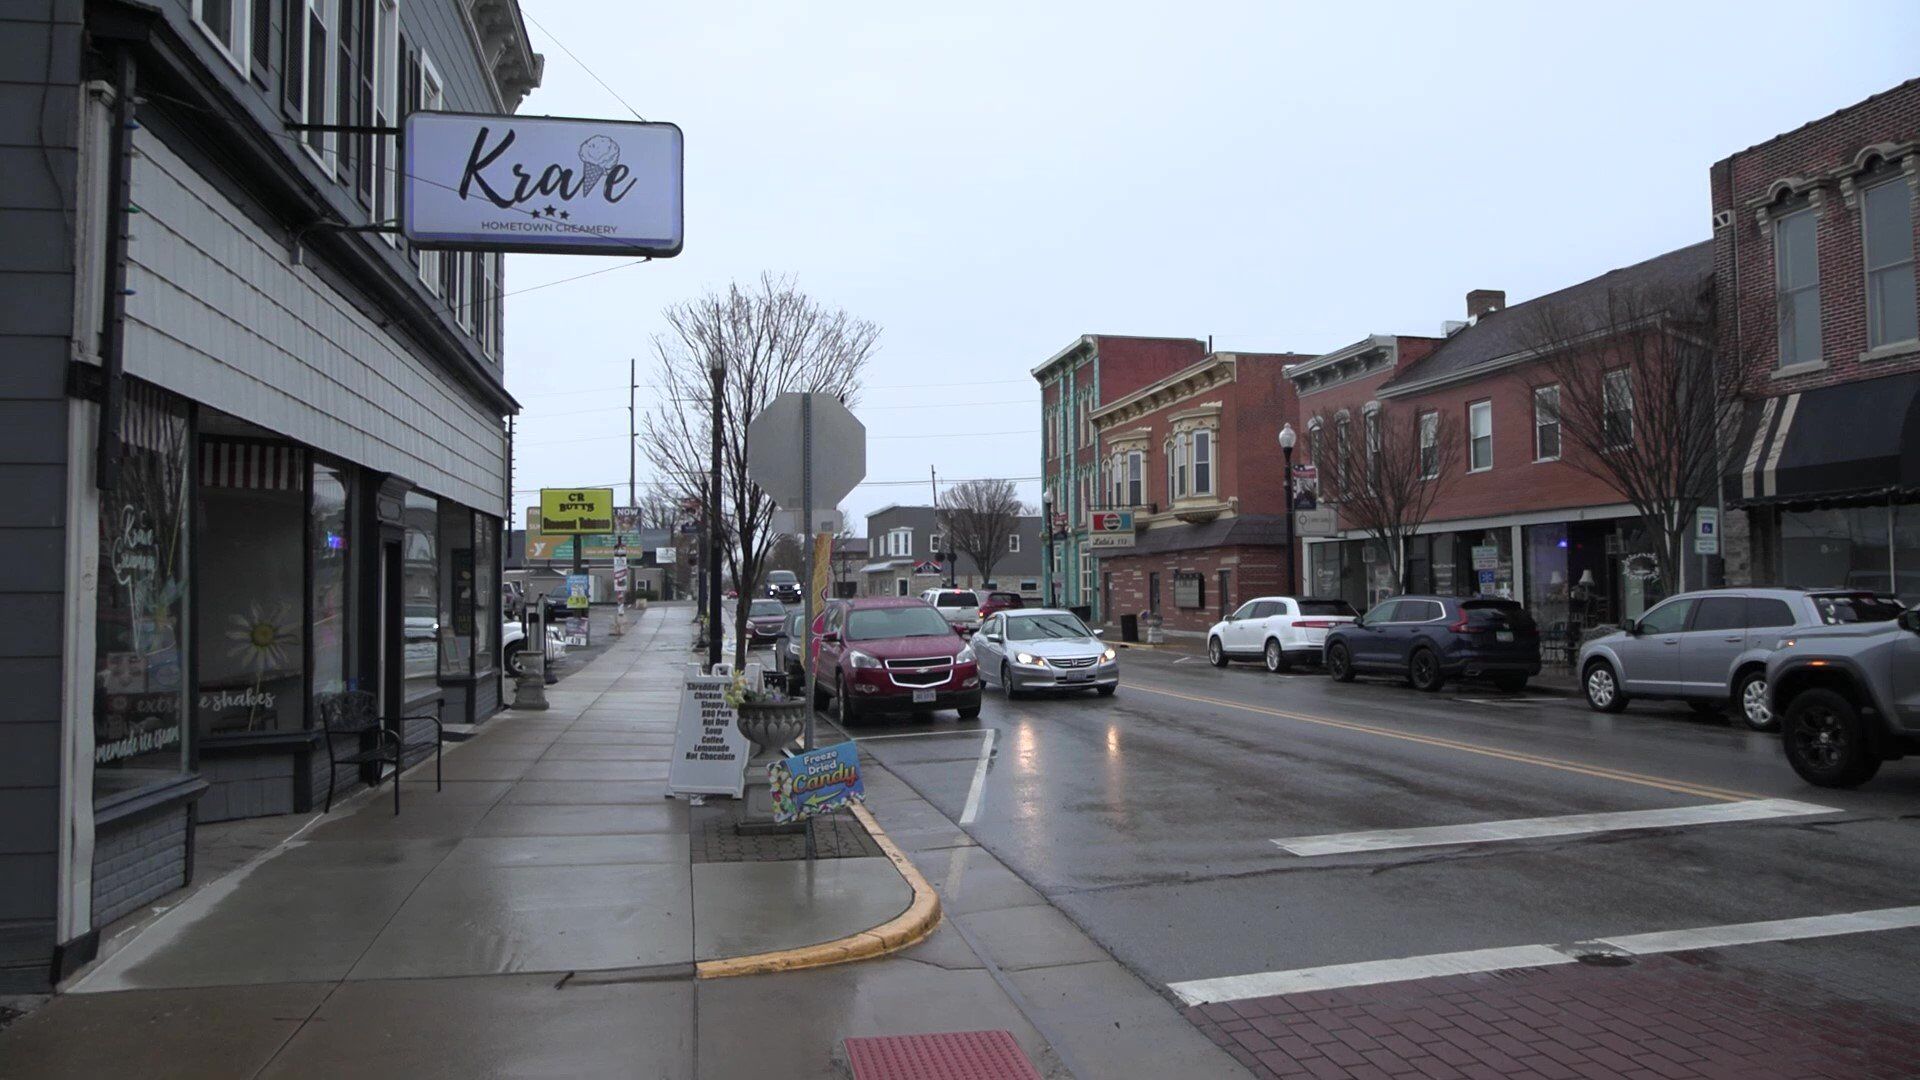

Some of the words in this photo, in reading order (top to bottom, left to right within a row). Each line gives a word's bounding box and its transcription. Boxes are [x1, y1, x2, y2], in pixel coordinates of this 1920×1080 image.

[458, 126, 638, 209] Krave
[481, 221, 553, 233] HOMETOWN
[555, 222, 618, 235] CREAMERY
[559, 503, 595, 512] BUTTS
[617, 508, 639, 516] NOW
[686, 682, 721, 691] Shredded
[212, 688, 276, 711] shakes
[701, 701, 725, 709] Sloppy
[716, 710, 732, 718] Pork
[715, 719, 729, 727] Dog
[704, 727, 723, 735] Soup
[701, 736, 724, 744] Coffee
[694, 744, 730, 752] Lemonade
[686, 752, 698, 760] Hot
[699, 752, 735, 760] Chocolate
[804, 751, 837, 765] Freeze
[808, 760, 837, 775] Dried
[792, 762, 858, 794] Candy
